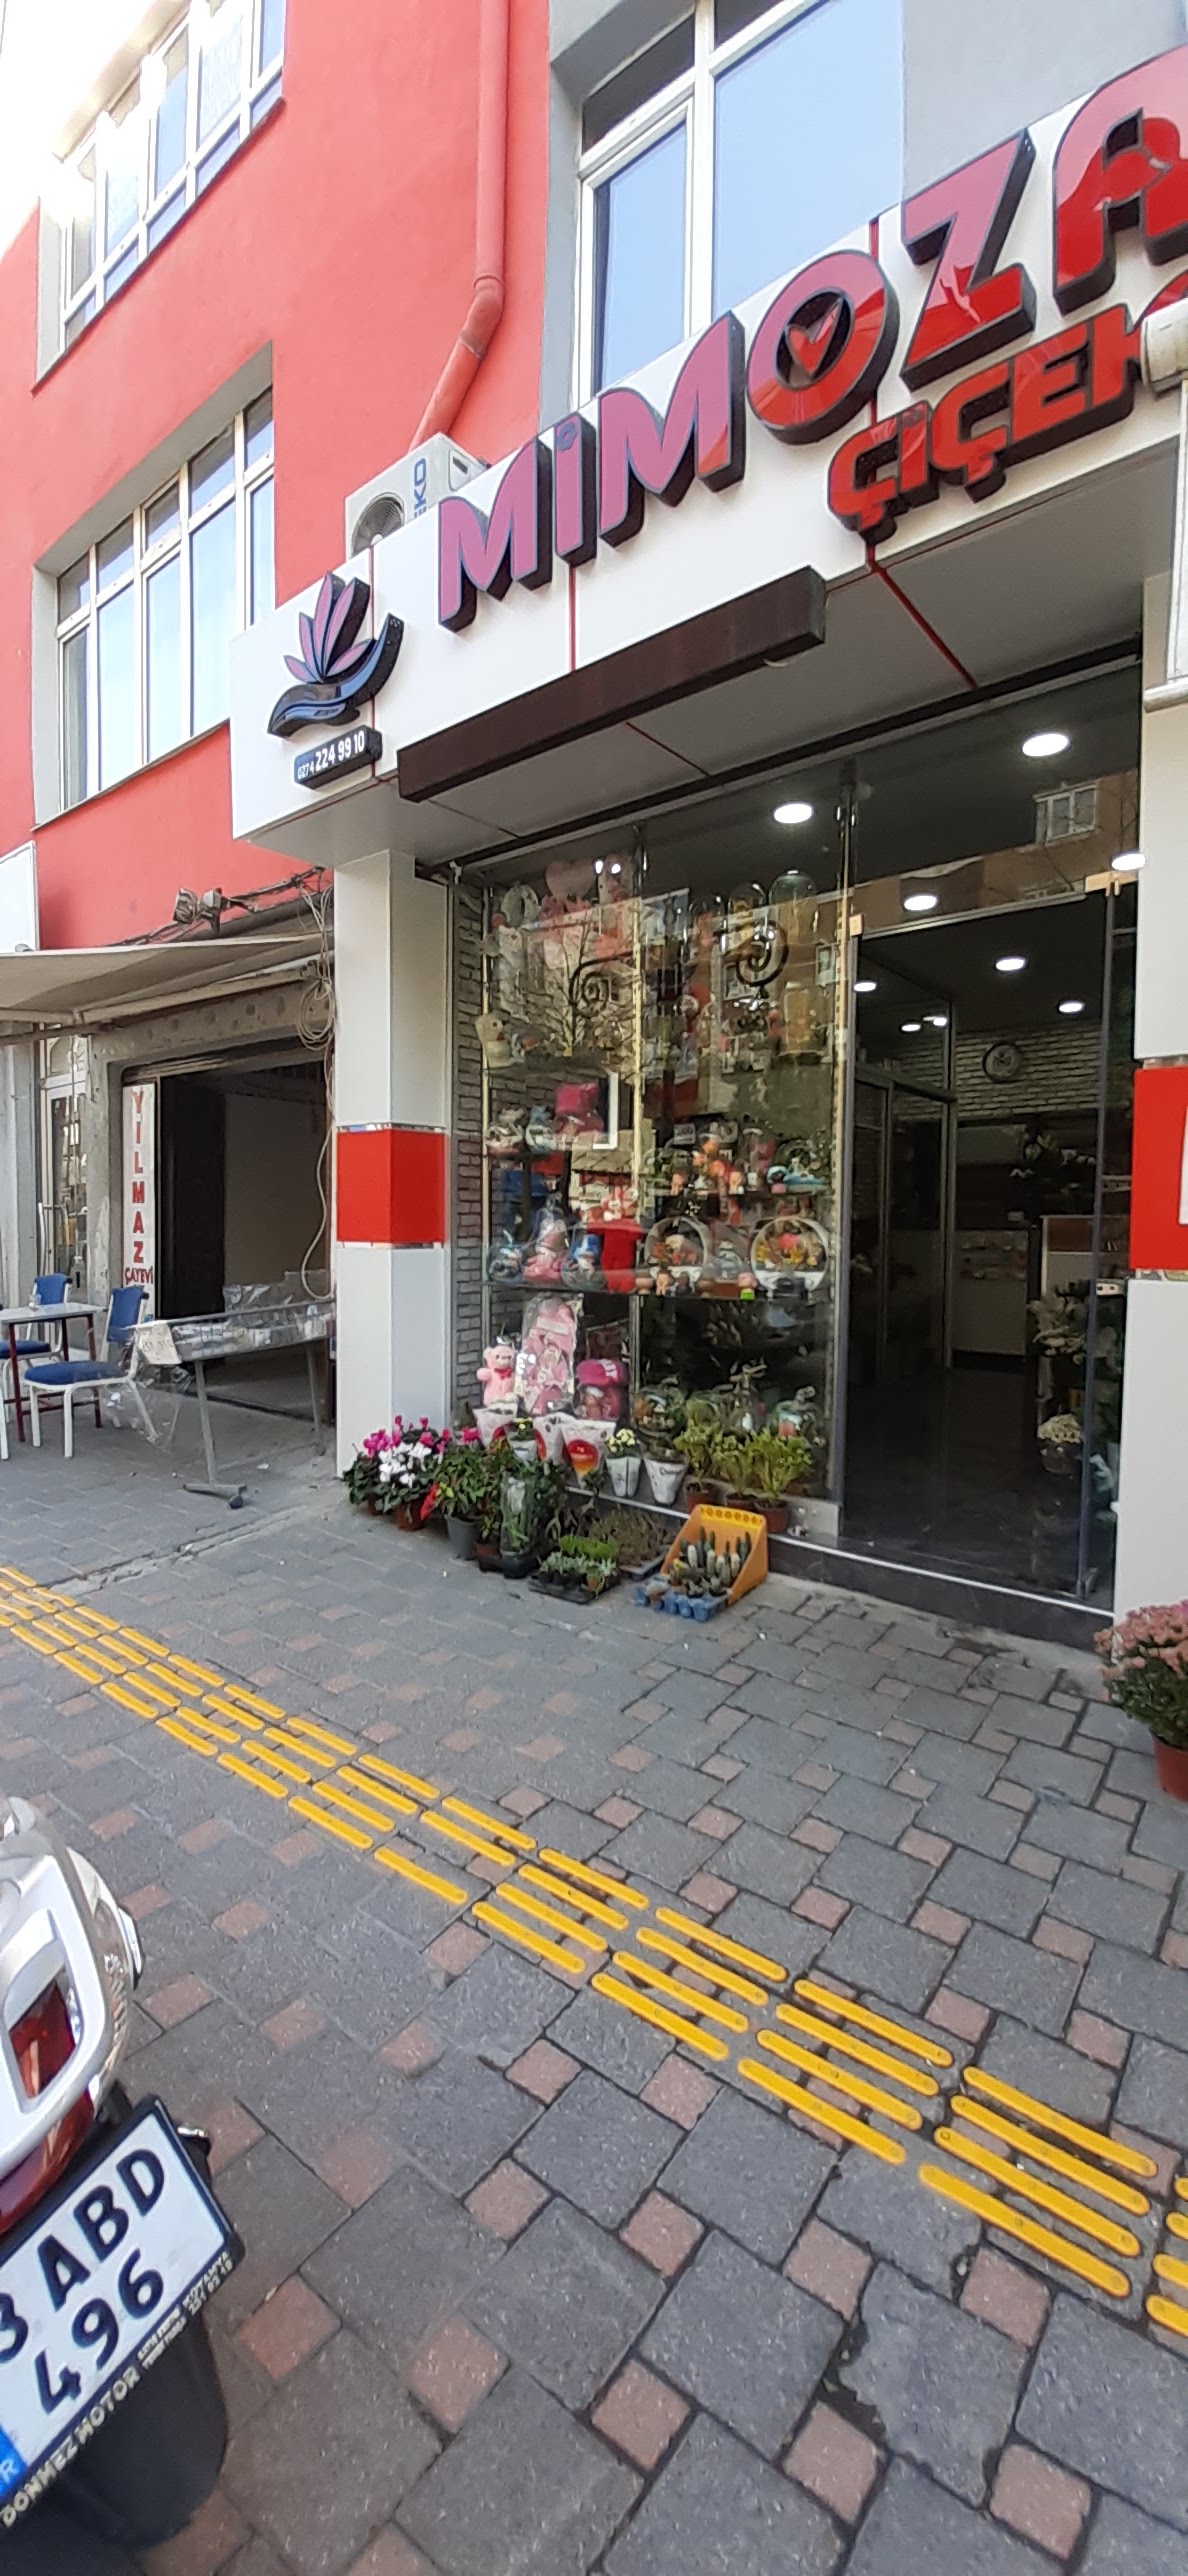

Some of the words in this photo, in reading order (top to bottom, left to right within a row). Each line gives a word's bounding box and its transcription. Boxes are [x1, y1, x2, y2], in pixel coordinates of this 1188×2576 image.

[438, 44, 1188, 630] MİMOZA
[315, 743, 336, 771] 224
[337, 736, 352, 762] 99
[353, 730, 365, 755] 10
[131, 1085, 145, 1264] YILMAZ
[125, 1265, 154, 1285] ÇAYEVİ
[37, 2149, 165, 2312] ABD
[34, 2249, 164, 2414] 496
[74, 2366, 142, 2445] MOTOR
